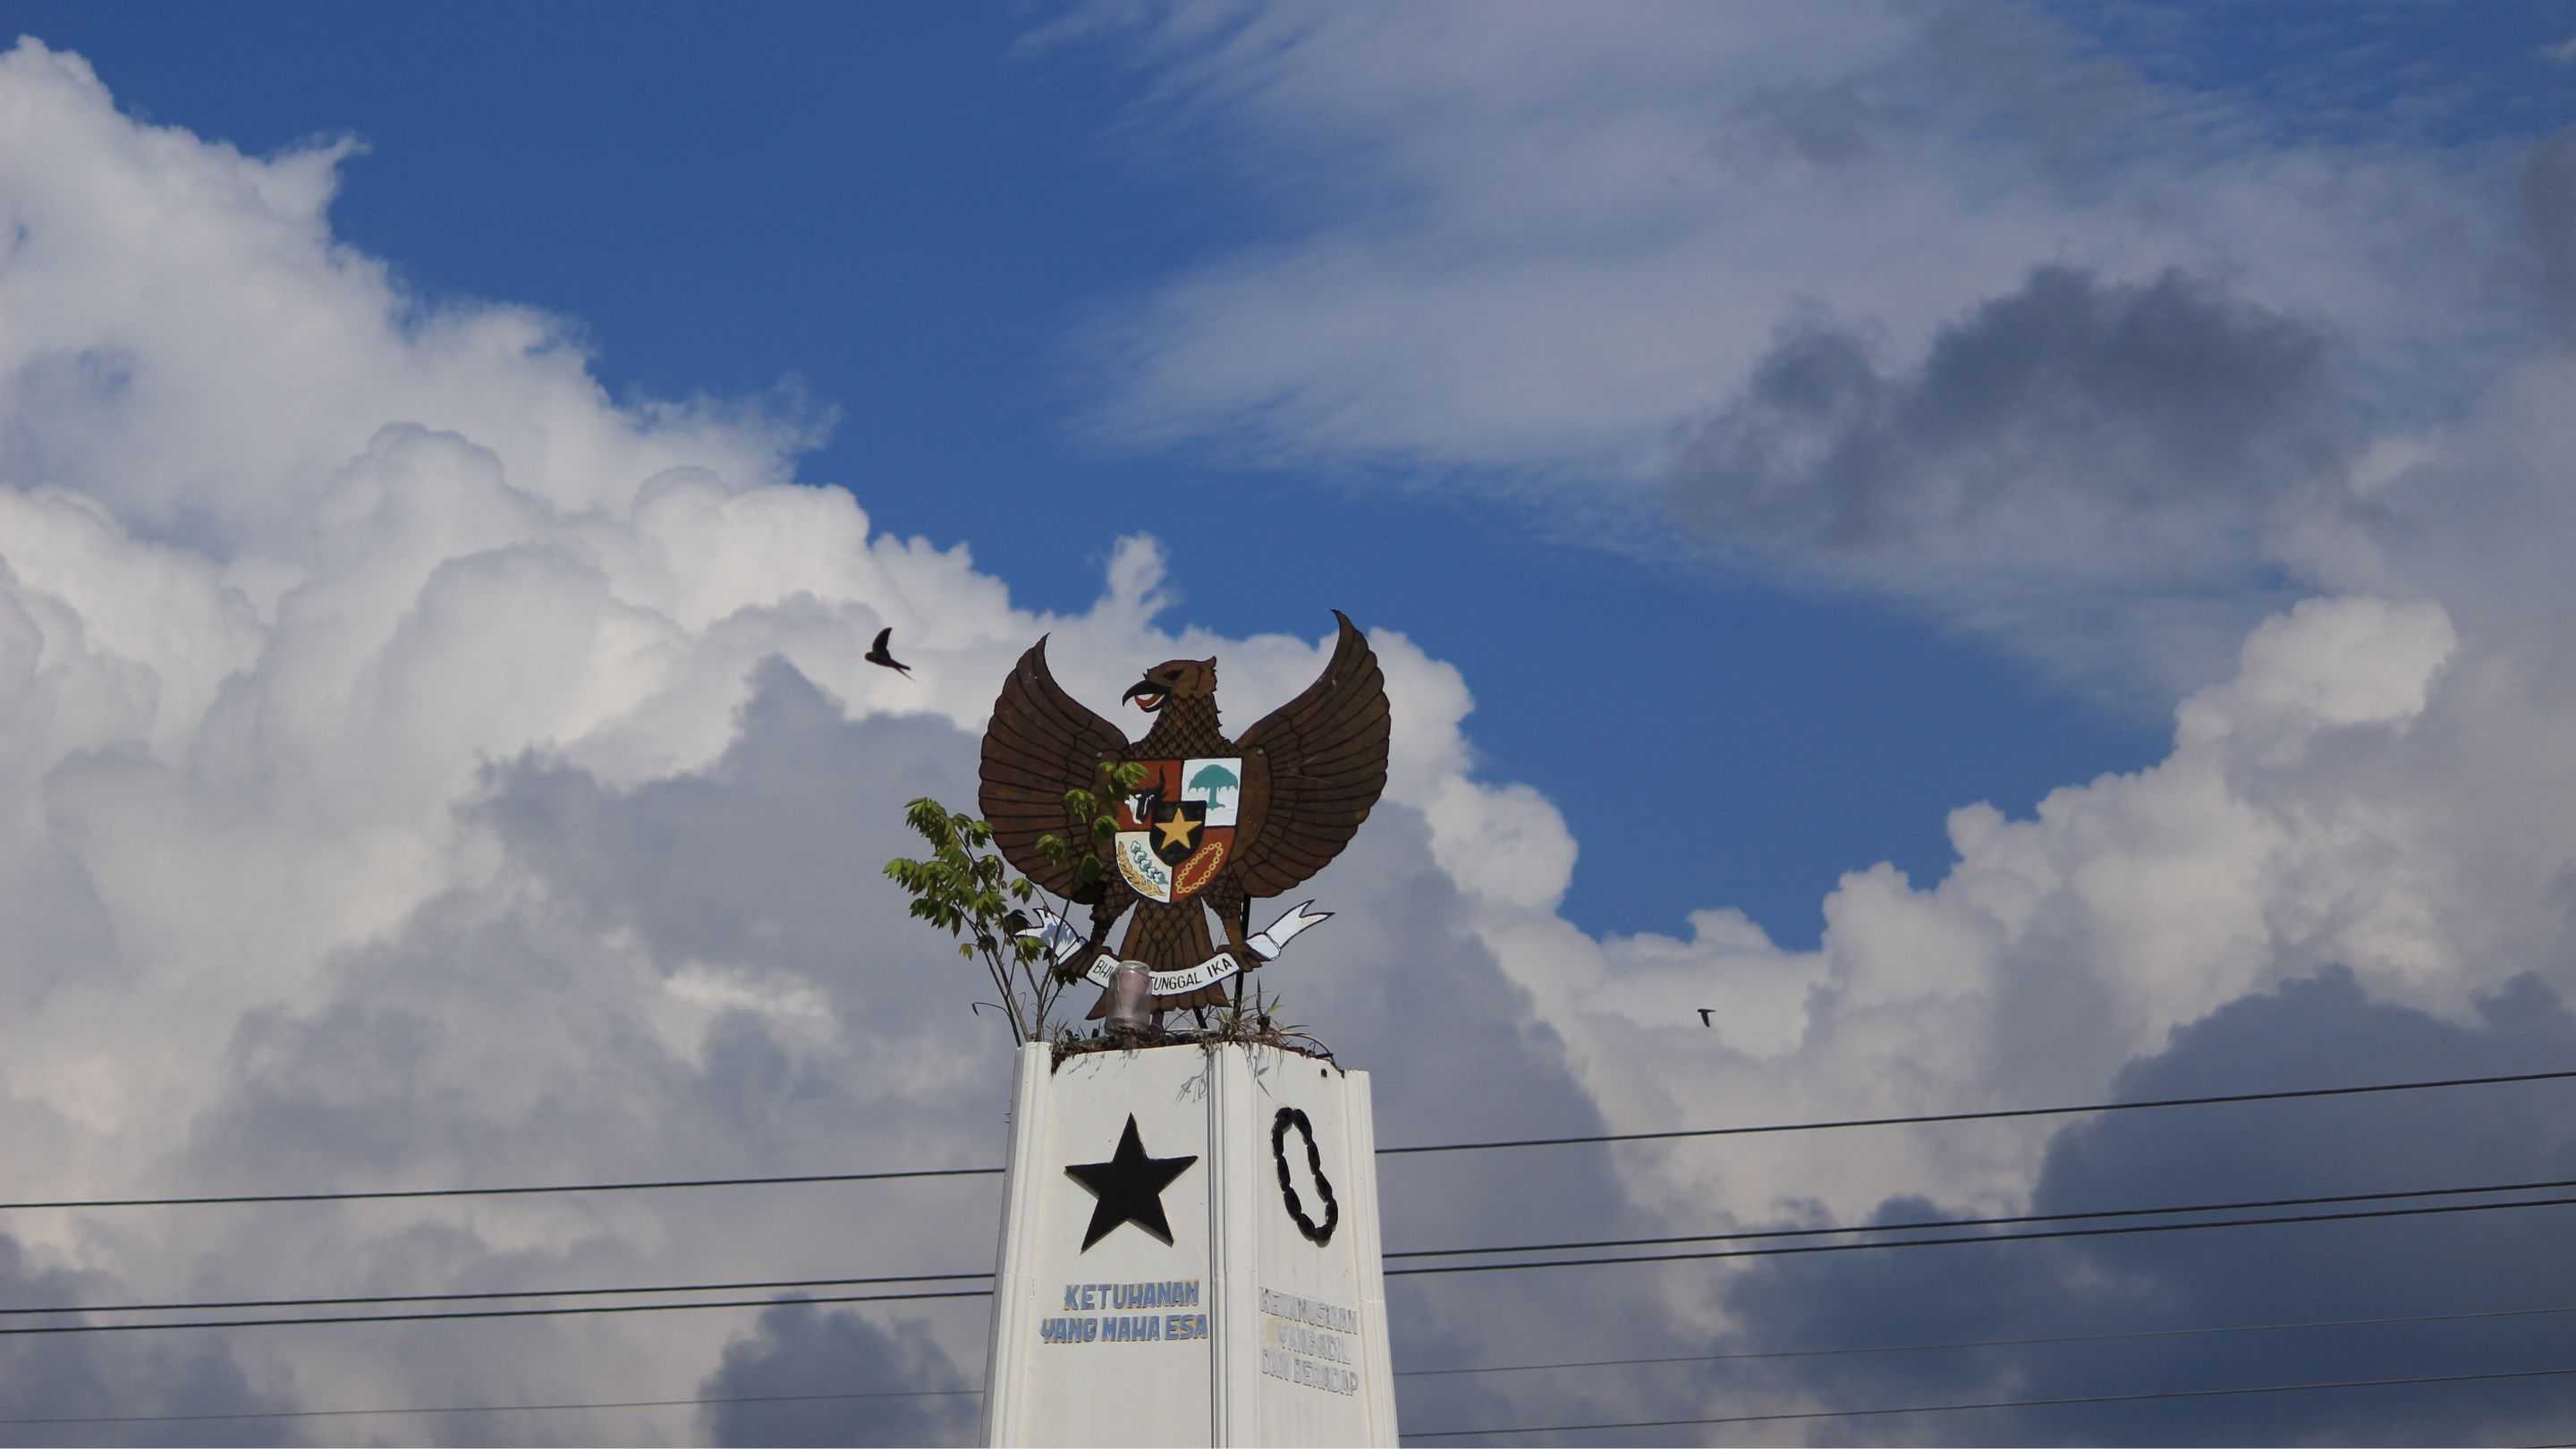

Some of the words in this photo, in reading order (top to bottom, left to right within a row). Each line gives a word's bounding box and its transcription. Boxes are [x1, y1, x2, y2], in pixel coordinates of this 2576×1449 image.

[1206, 957, 1233, 978] IKA
[1063, 1281, 1200, 1311] KETUHANAN
[1040, 1318, 1098, 1344] YANG
[1101, 1316, 1161, 1343] MAHA
[1165, 1314, 1208, 1341] ESA
